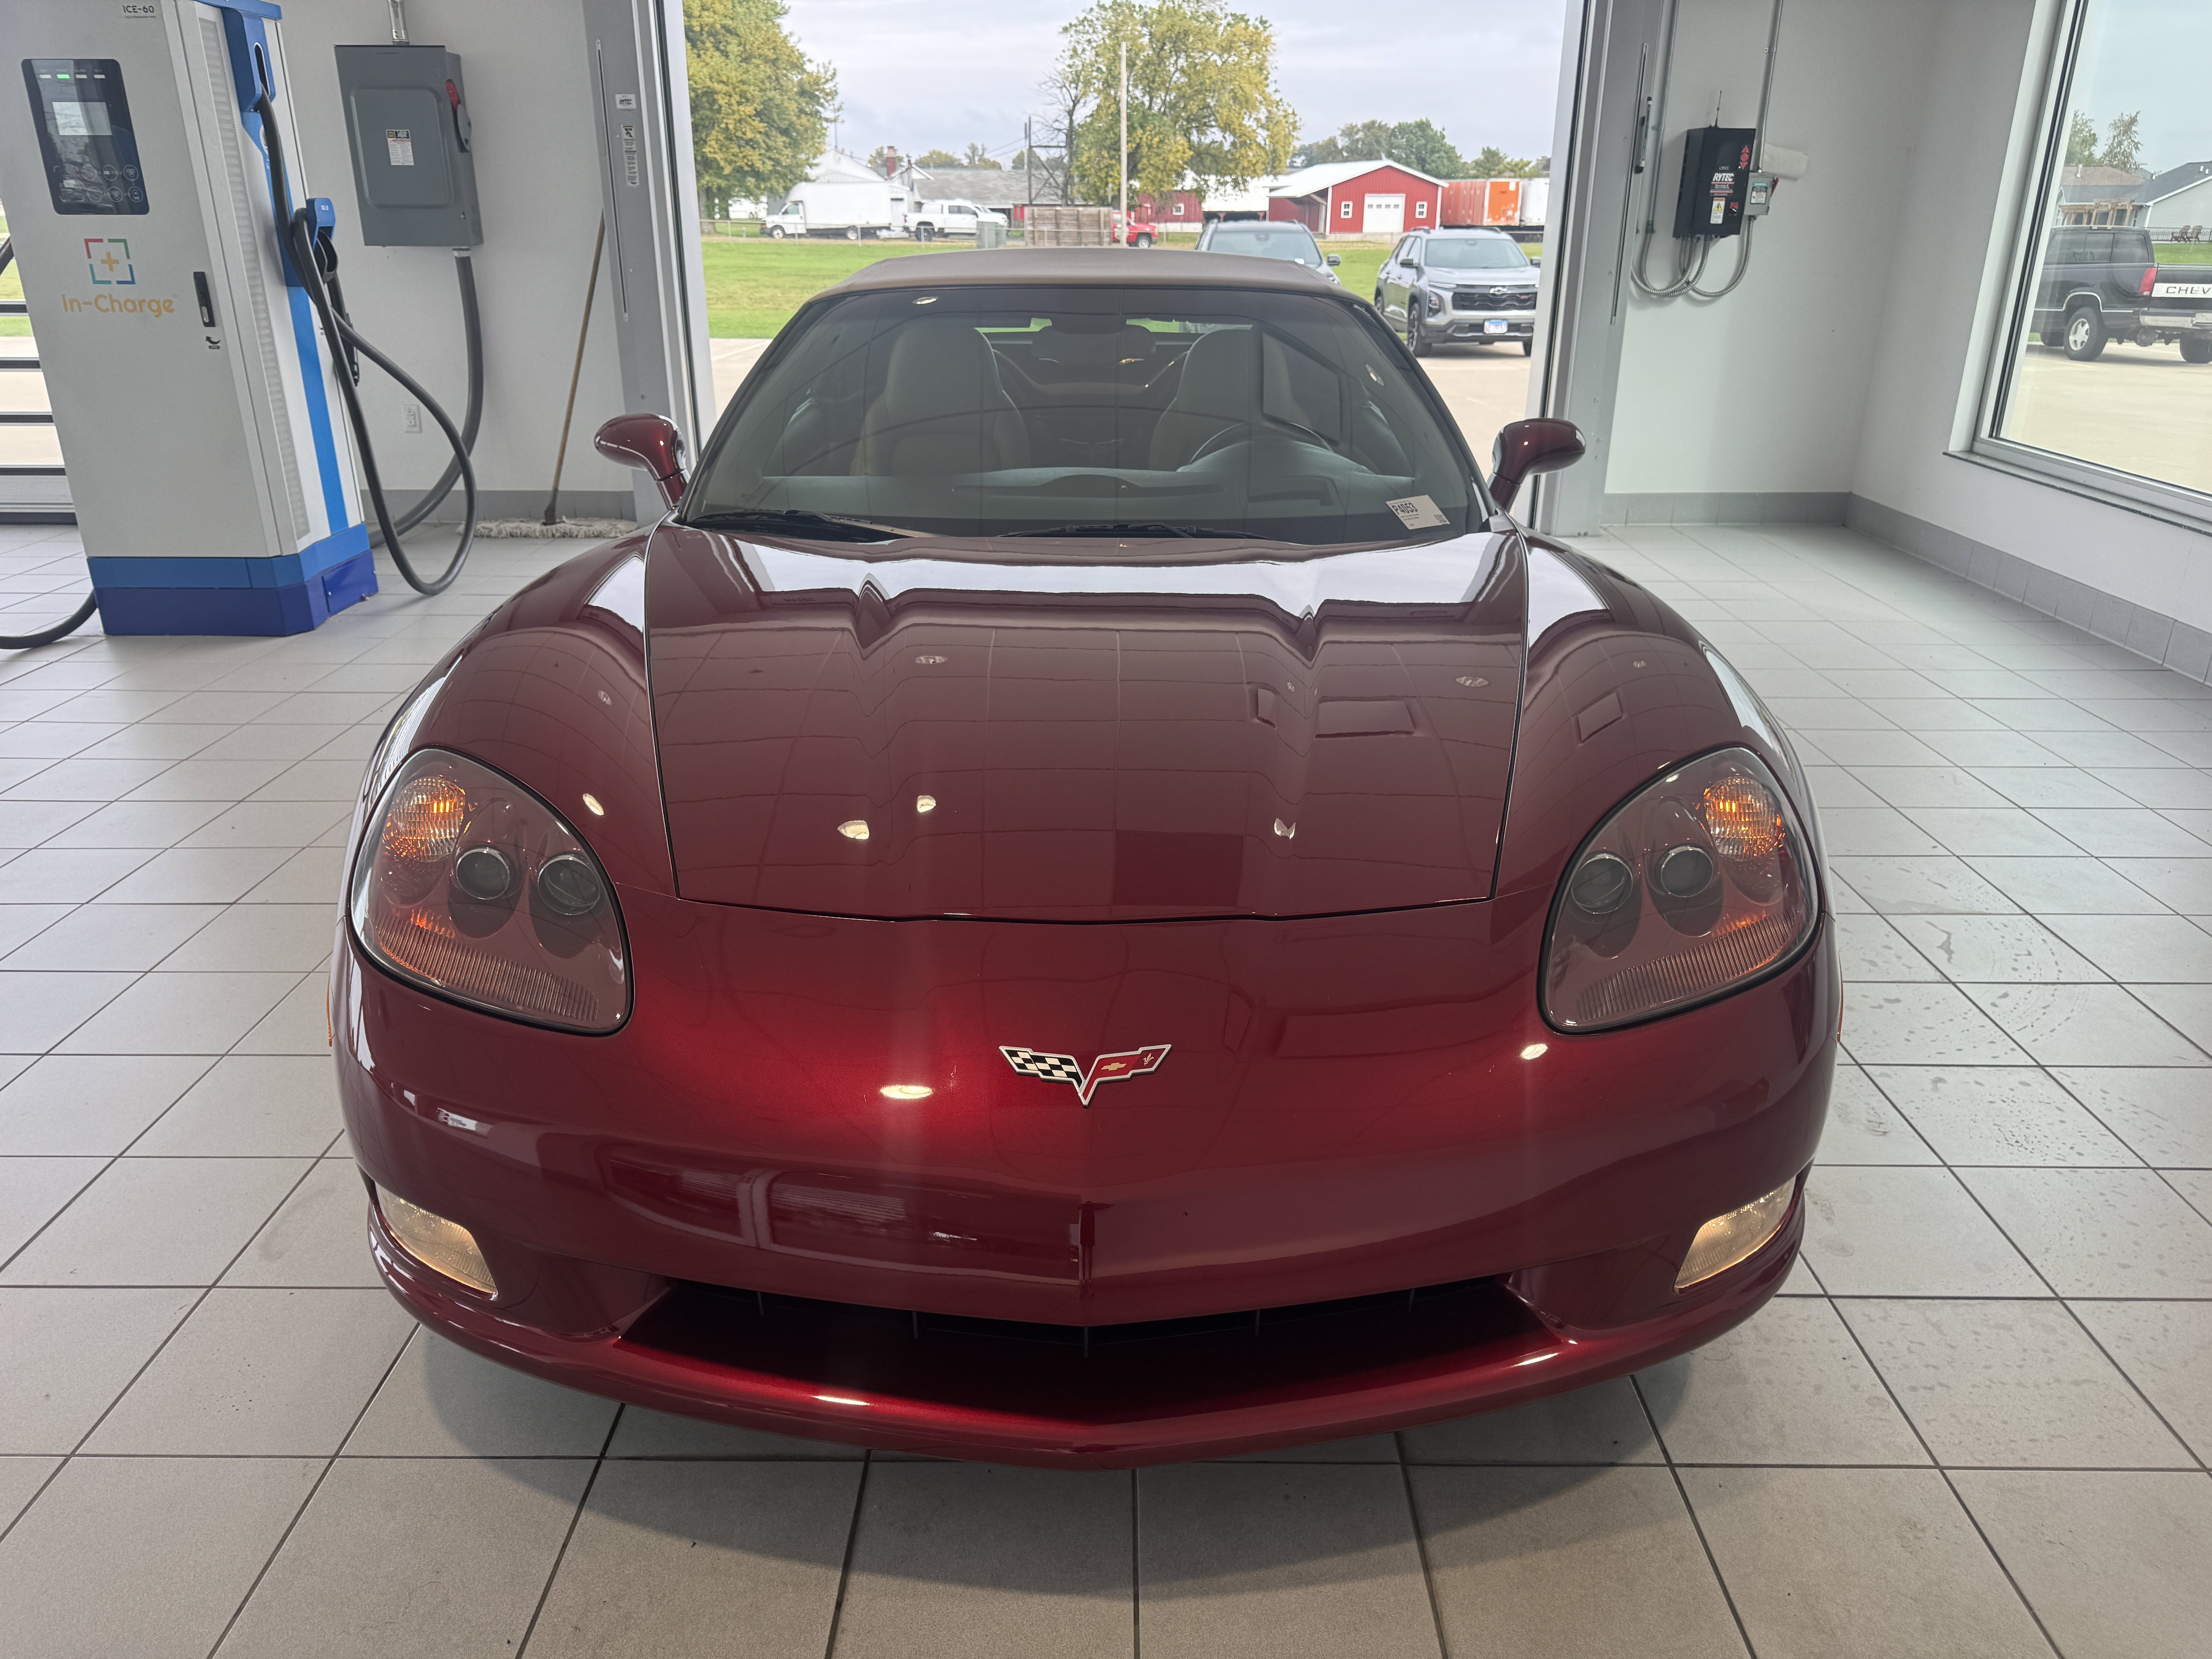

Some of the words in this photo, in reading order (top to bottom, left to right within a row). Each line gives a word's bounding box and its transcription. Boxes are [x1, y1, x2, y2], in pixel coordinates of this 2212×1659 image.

[1712, 173, 1735, 182] RYTEC
[61, 294, 175, 318] In-Charge
[1391, 503, 1418, 515] P4053
